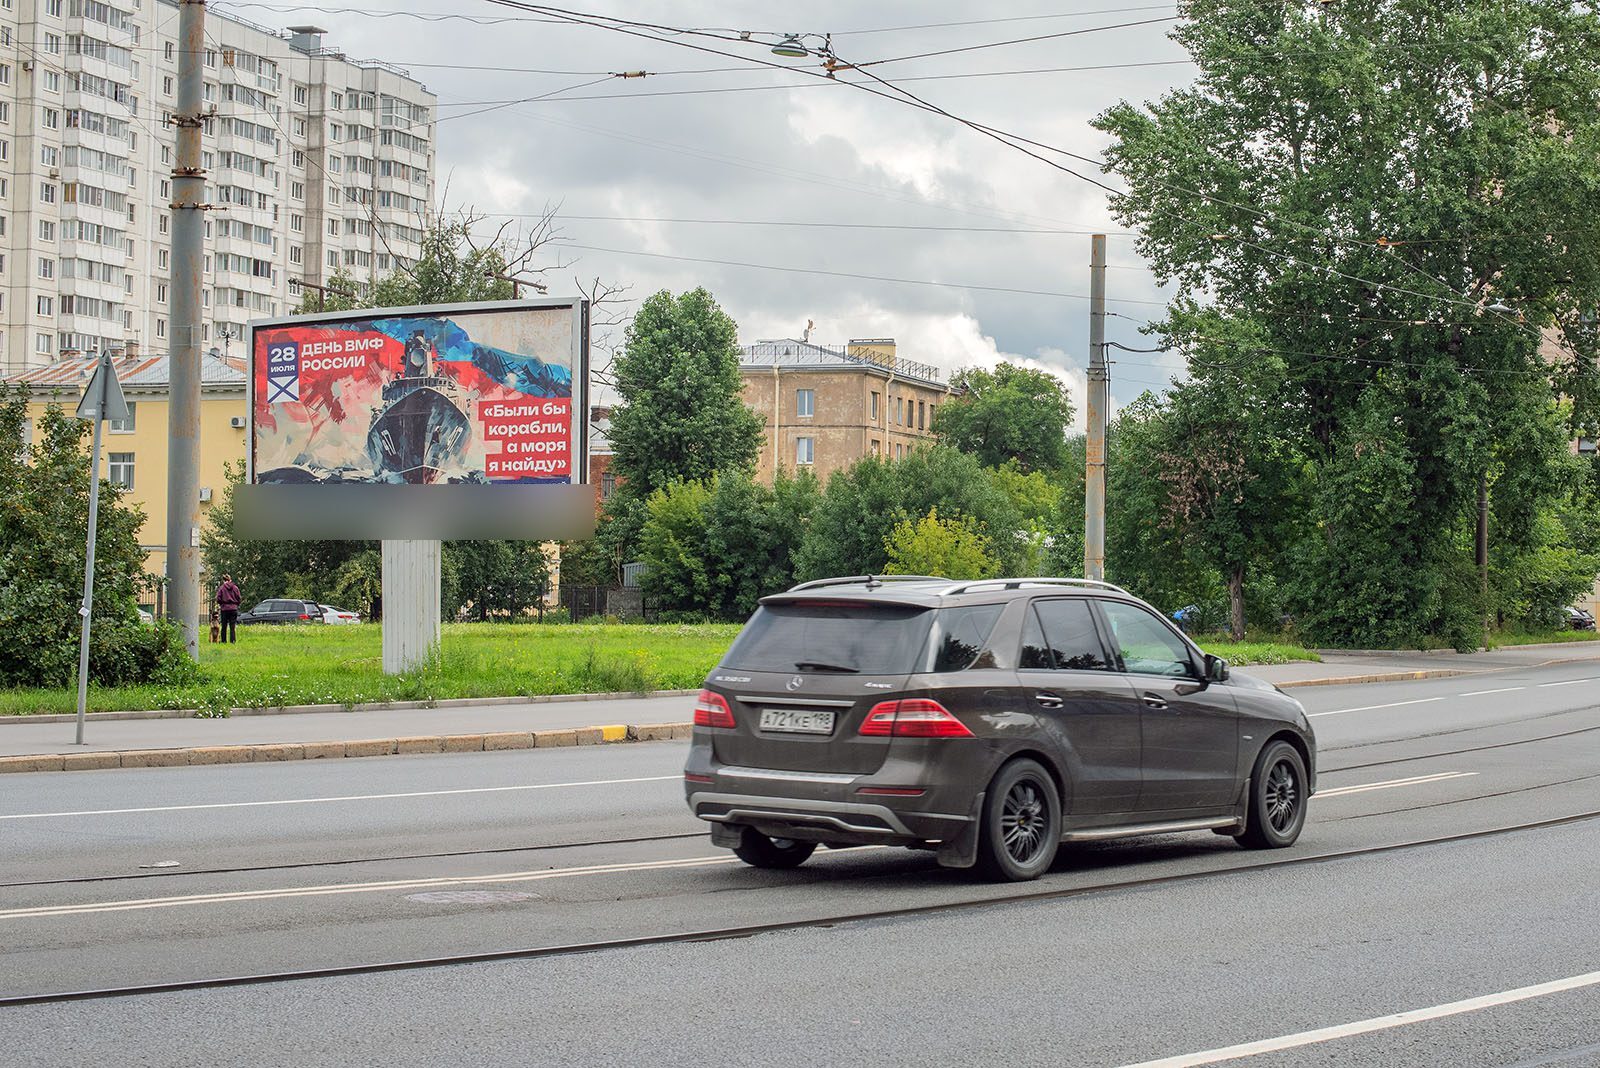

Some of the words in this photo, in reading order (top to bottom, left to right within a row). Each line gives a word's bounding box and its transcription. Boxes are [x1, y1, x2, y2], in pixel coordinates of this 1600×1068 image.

[270, 346, 296, 363] 28
[301, 342, 343, 358] ДЕНЬ
[345, 337, 384, 352] ВМФ
[301, 355, 366, 372] РОССИИ
[484, 404, 539, 417] «Были
[542, 402, 566, 416] бы
[488, 420, 567, 437] корабли,
[506, 442, 518, 453] а
[521, 441, 566, 454] моря
[488, 461, 499, 472] я
[501, 456, 567, 472] найду»
